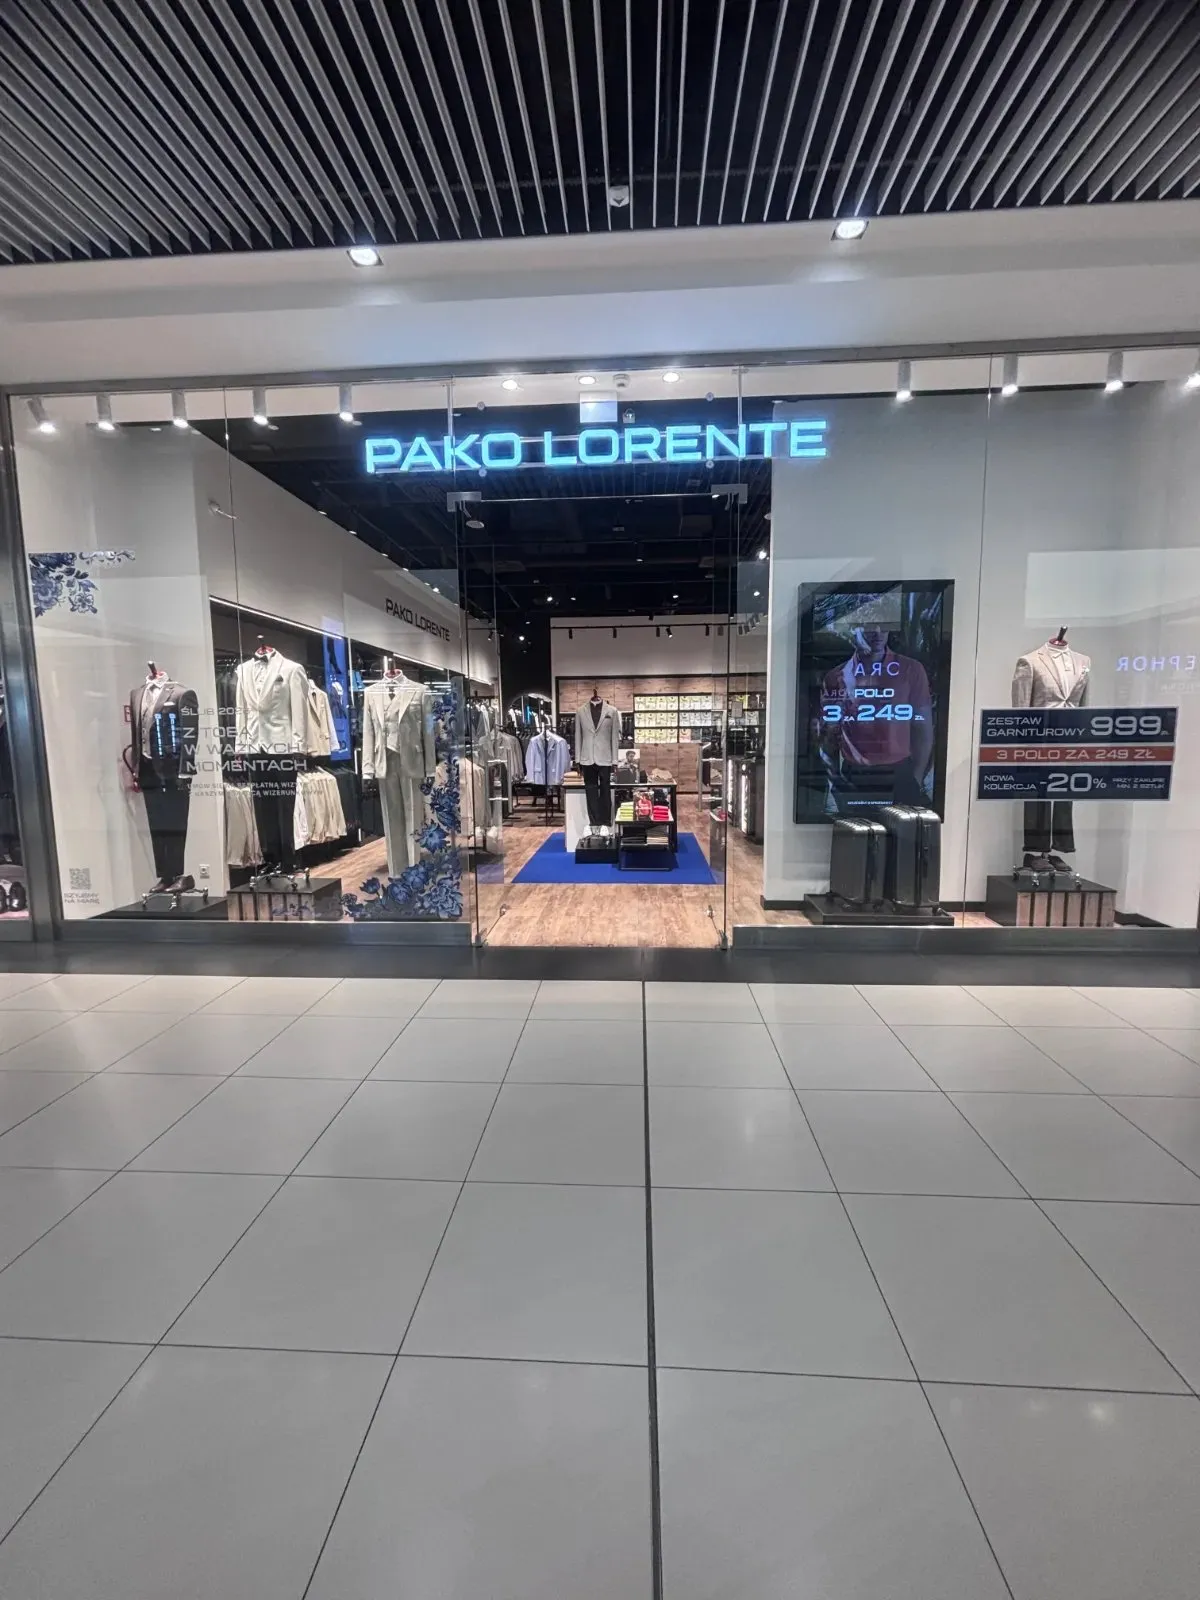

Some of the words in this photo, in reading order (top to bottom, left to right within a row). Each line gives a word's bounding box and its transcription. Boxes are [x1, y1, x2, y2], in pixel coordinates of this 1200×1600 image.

[365, 432, 522, 474] PAKO
[543, 421, 828, 466] LORENTE
[386, 598, 413, 625] PAKO
[415, 613, 451, 642] LORENTE
[854, 688, 895, 698] POLO
[180, 706, 215, 716] ŚLUB
[822, 705, 843, 722] 3
[857, 704, 913, 721] 249
[986, 716, 1042, 726] ZESTAW
[1090, 715, 1162, 736] 999
[183, 726, 196, 739] Z
[986, 727, 1085, 738] GARNITUROWY
[184, 744, 200, 756] W
[996, 750, 1008, 761] 3
[1013, 750, 1061, 761] POLO
[1065, 750, 1090, 760] ZA
[1095, 749, 1129, 760] 249
[1134, 748, 1156, 760] ZŁ
[186, 759, 308, 772] MOMENTACH
[983, 775, 1015, 783] NOWA
[983, 783, 1037, 791] KOLEKCJA
